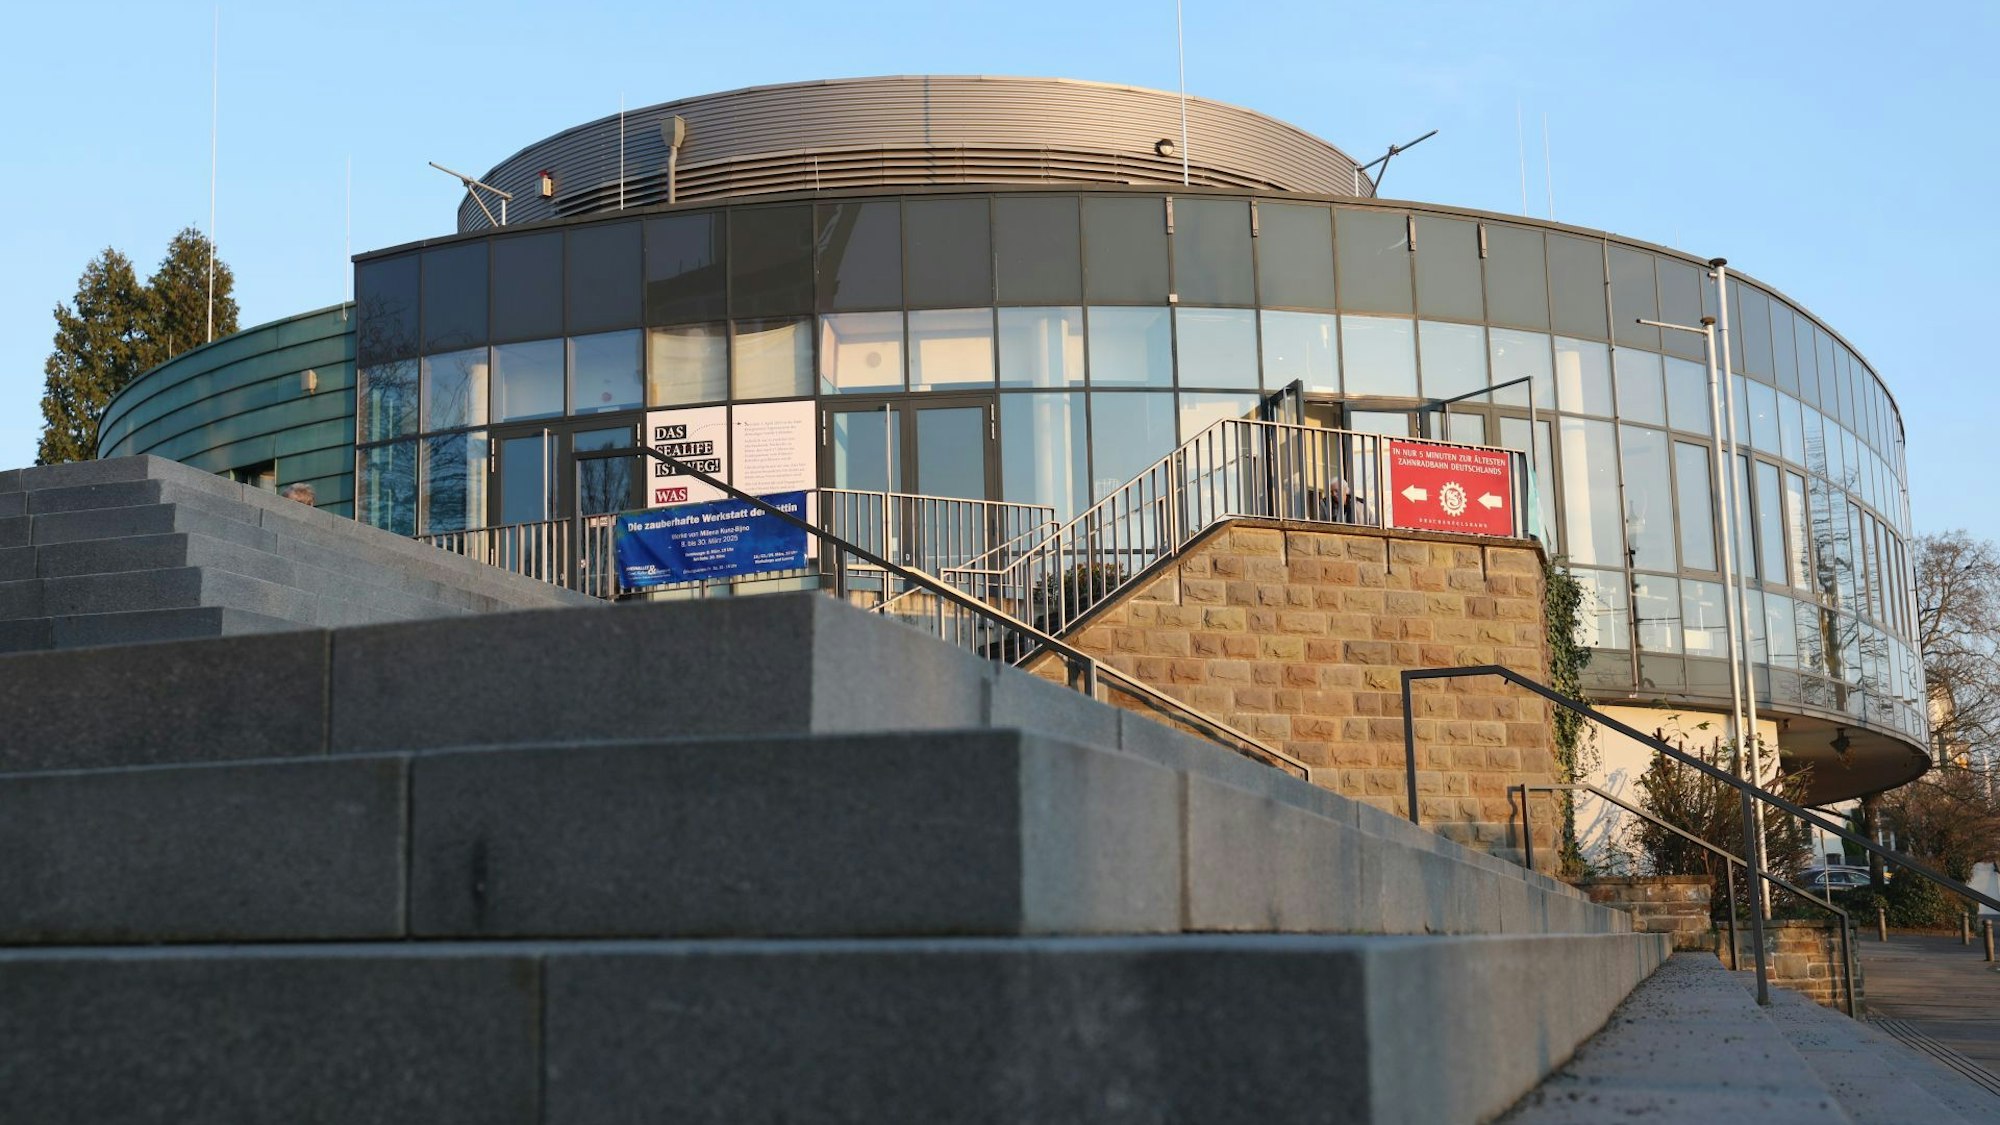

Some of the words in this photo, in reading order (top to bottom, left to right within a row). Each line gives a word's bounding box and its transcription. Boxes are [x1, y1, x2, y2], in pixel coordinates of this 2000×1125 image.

[656, 426, 684, 440] DAS
[656, 442, 713, 457] SEALIFE
[1392, 447, 1401, 456] IN
[1402, 449, 1417, 457] NUR
[1425, 451, 1457, 462] MINUTEN
[1458, 454, 1472, 463] ZUR
[1474, 455, 1506, 467] ÄLTESTEN
[1398, 458, 1449, 470] ZAHNRADBAHN
[1451, 463, 1502, 475] DEUTSCHLANDS
[656, 488, 687, 502] WAS
[627, 522, 643, 532] Die
[645, 514, 700, 530] zauberhafte
[702, 508, 748, 523] Werkstatt
[708, 537, 722, 545] März
